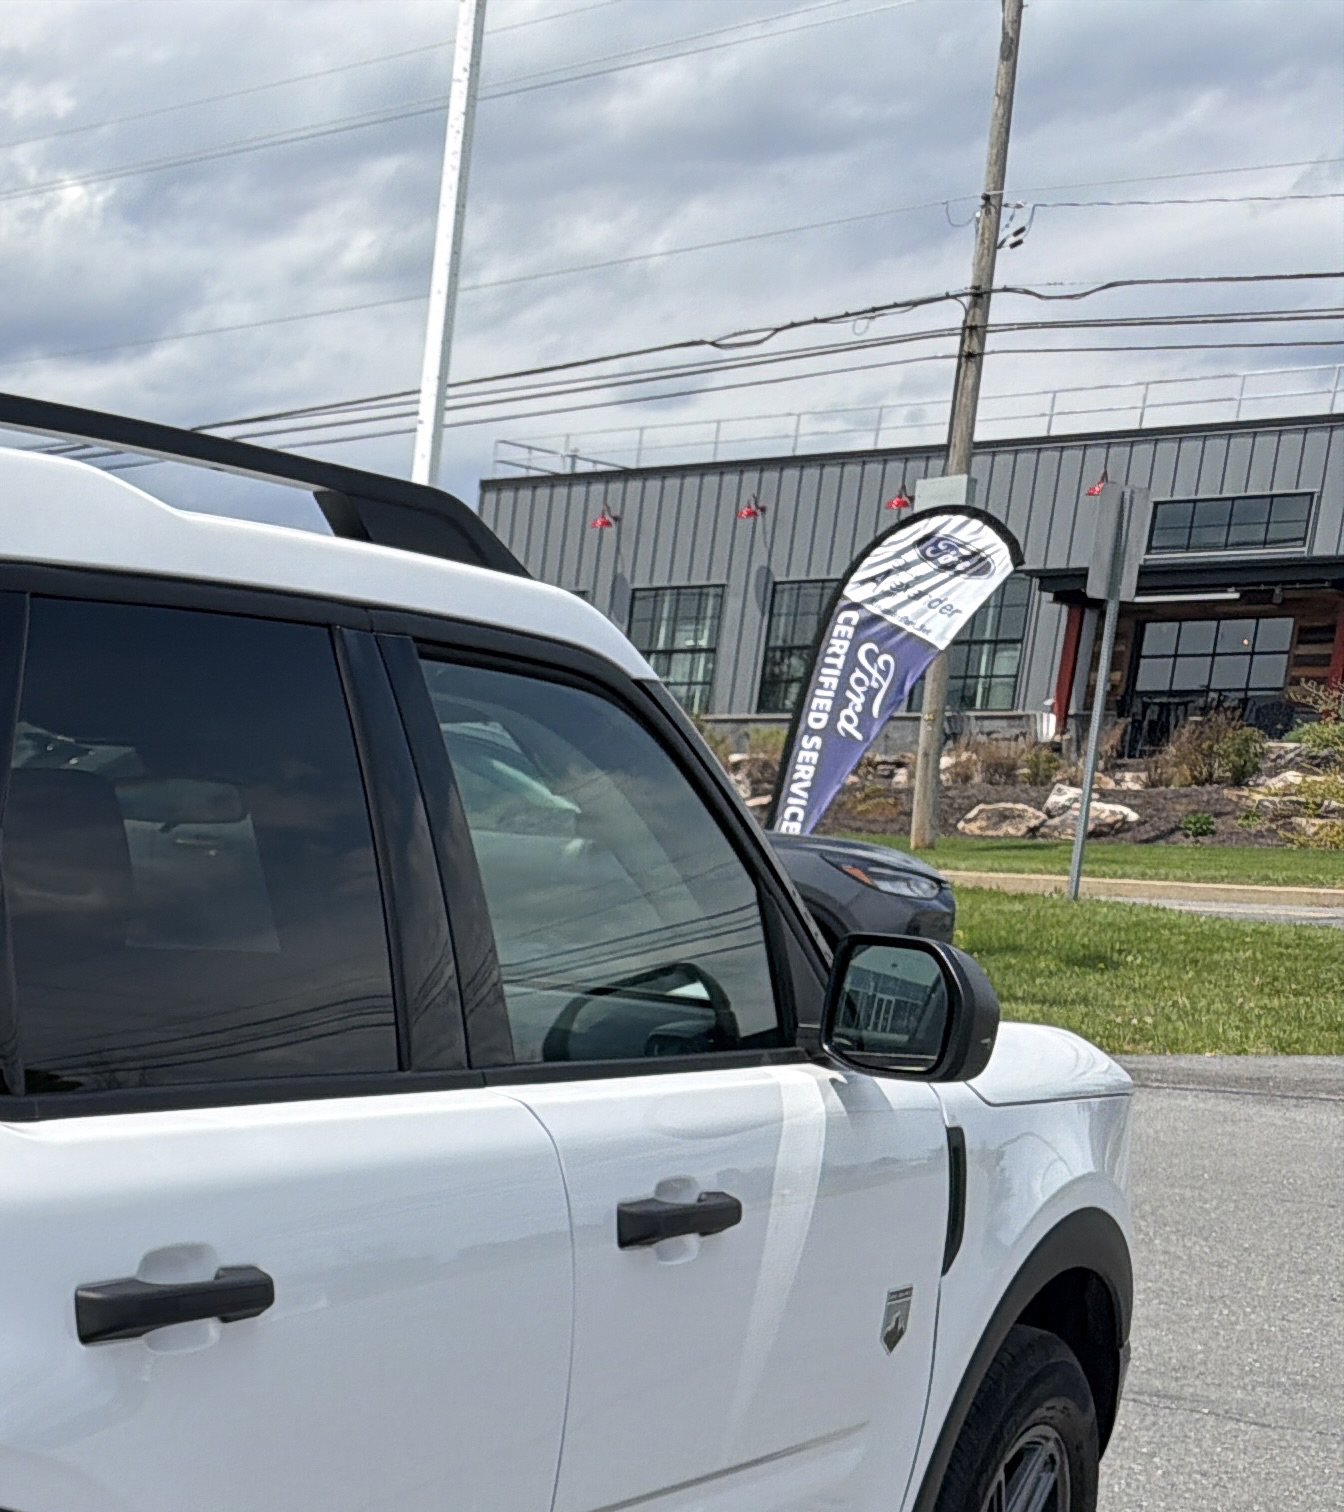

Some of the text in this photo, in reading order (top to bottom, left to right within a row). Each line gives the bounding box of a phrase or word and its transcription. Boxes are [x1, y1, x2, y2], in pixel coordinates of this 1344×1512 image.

[780, 610, 860, 835] CERTIFIED SERVICE
[837, 642, 895, 742] Ford
